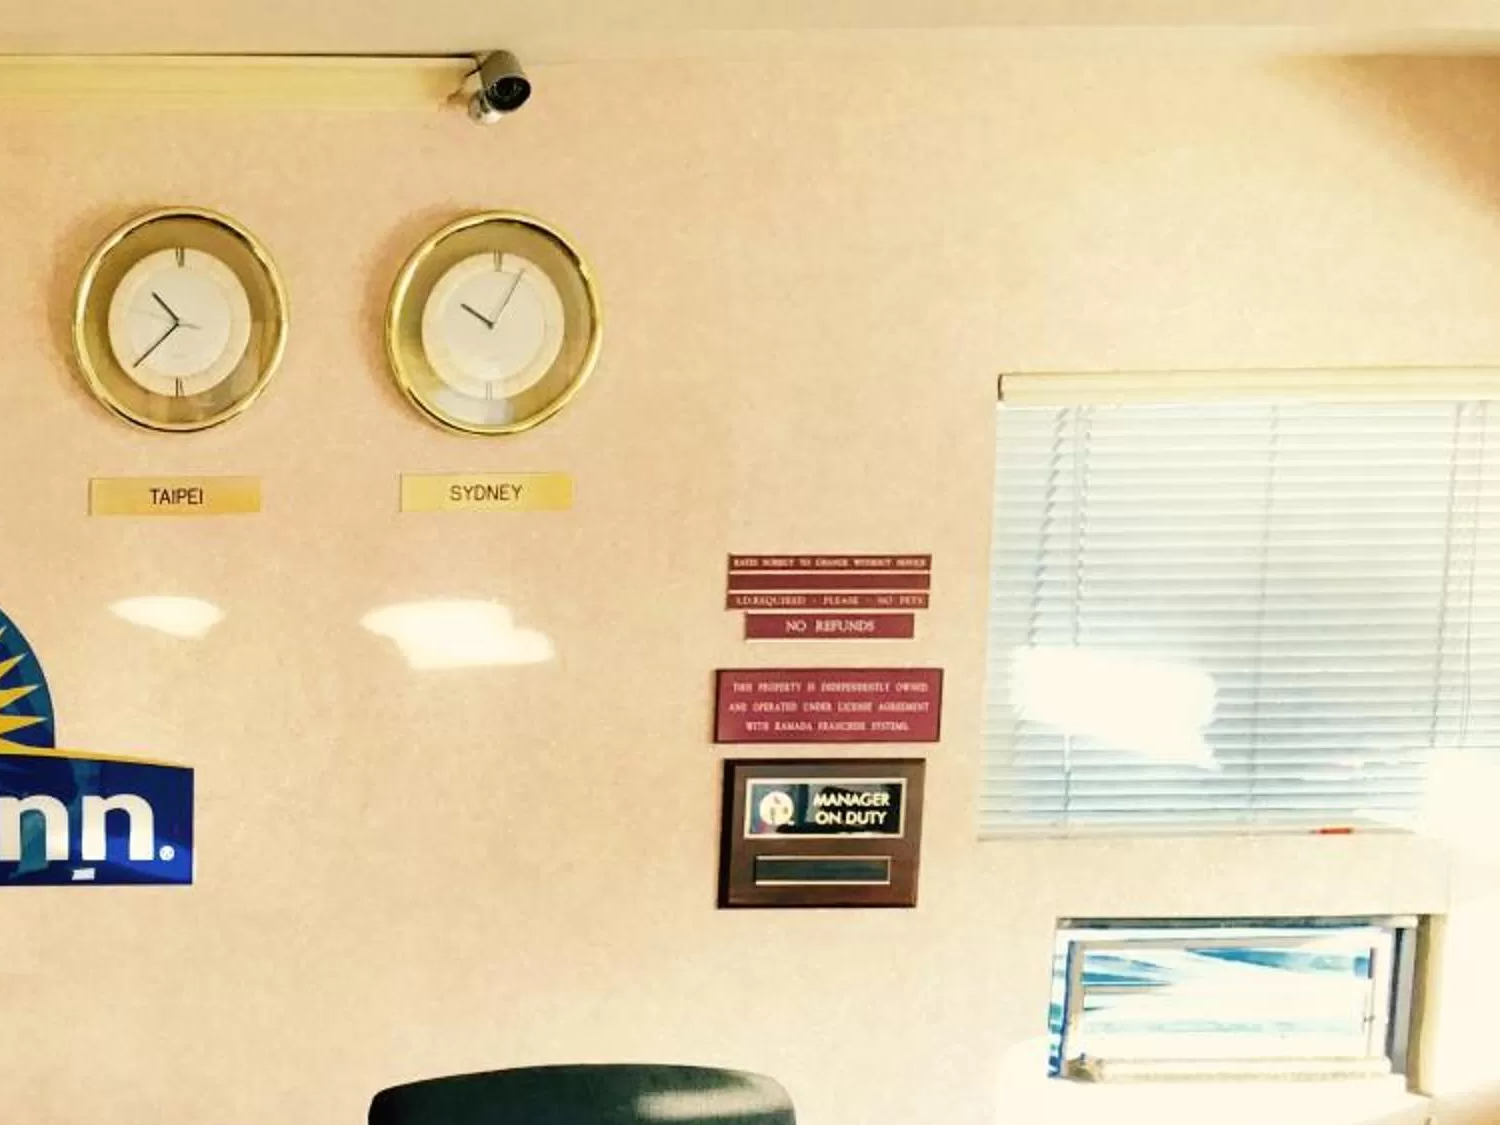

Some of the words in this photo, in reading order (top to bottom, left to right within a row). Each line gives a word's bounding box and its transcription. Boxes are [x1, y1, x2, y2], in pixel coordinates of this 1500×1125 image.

[148, 488, 205, 505] TAIPEI
[449, 484, 523, 502] SYDNEY
[785, 619, 807, 632] NO
[815, 620, 876, 633] REFUNDS
[758, 682, 801, 693] PROPERTY
[895, 682, 929, 693] OWNED
[752, 702, 797, 712] OPERATED
[803, 702, 833, 712] UNDER
[878, 702, 931, 712] AGREEMENT
[745, 721, 770, 732] WITH
[774, 721, 813, 732] RAMADA
[813, 792, 890, 807] MANAGER
[815, 811, 842, 825] ON
[845, 811, 887, 825] DUTY
